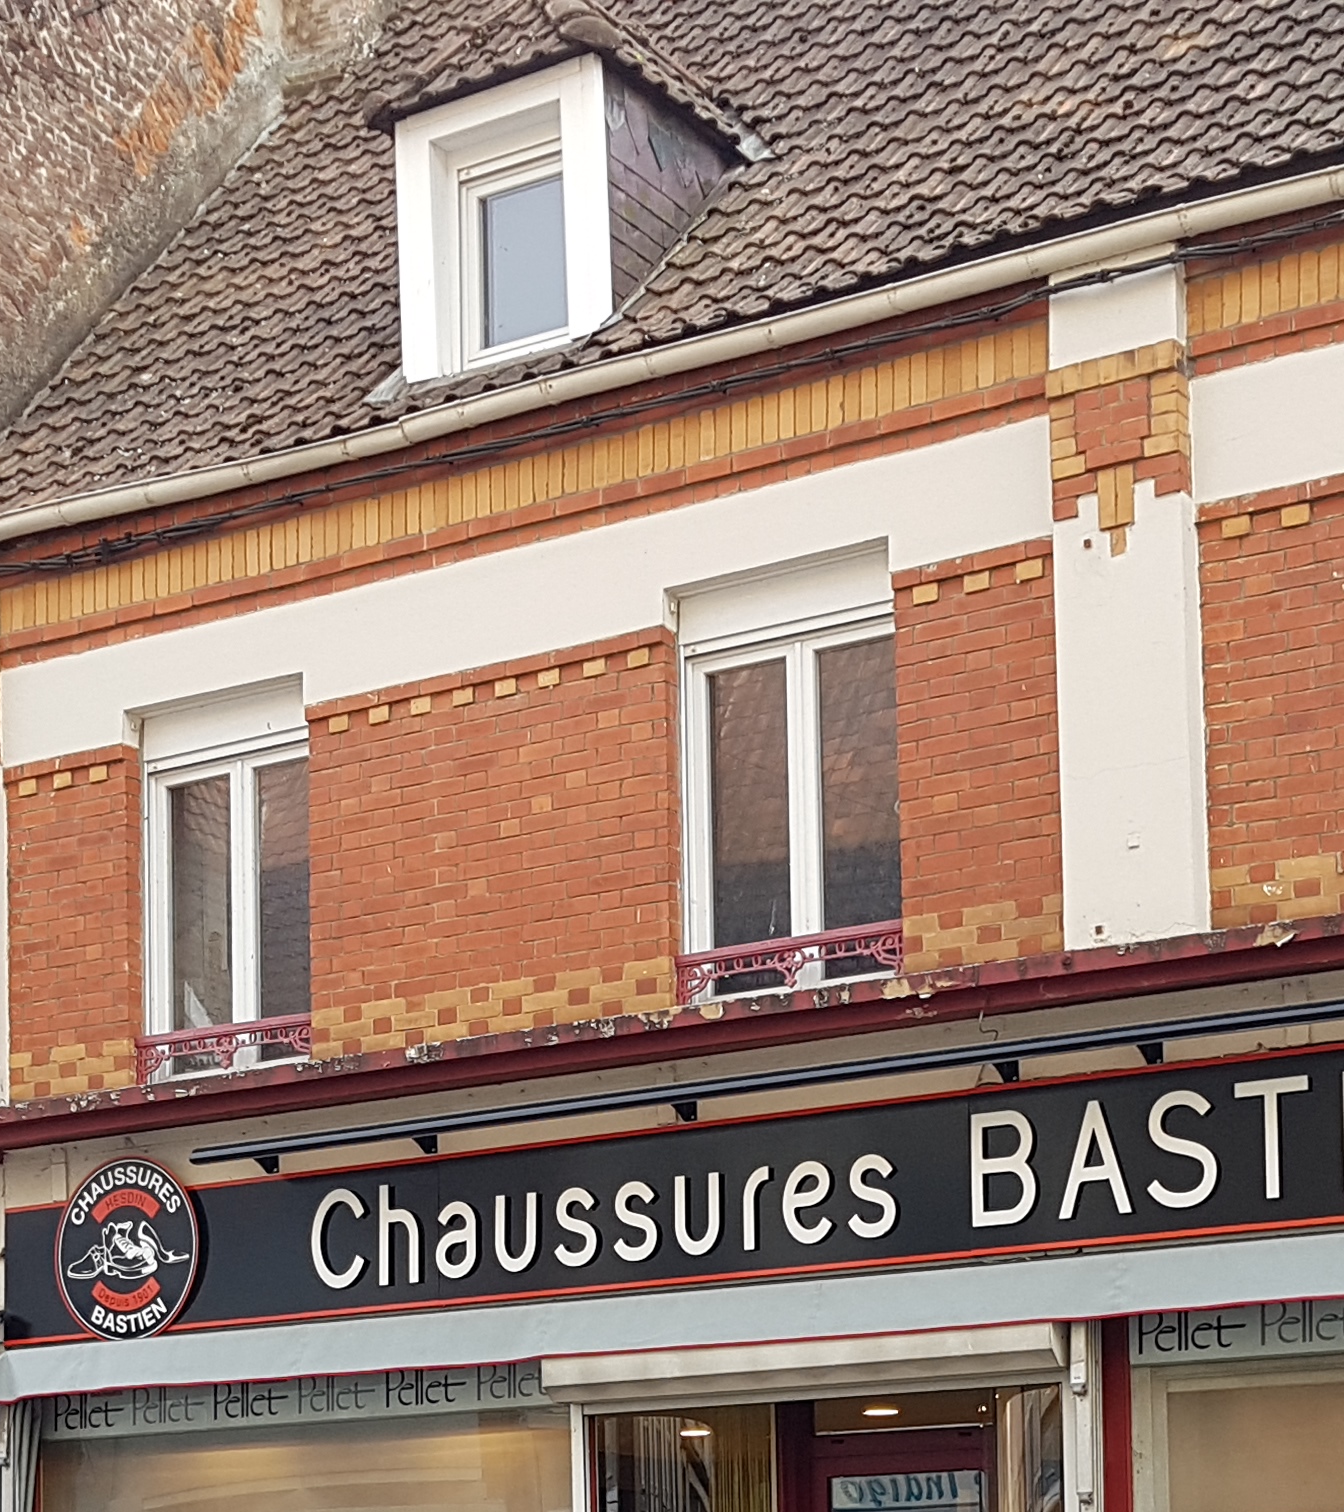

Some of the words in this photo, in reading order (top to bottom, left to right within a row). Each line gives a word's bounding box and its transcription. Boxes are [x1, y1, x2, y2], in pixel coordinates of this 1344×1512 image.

[71, 1166, 181, 1226] CHAUSSURES
[105, 1191, 146, 1211] HESDIN
[311, 1153, 897, 1290] Chaussures
[91, 1297, 168, 1334] BASTIEN
[98, 1288, 130, 1307] Depuis
[132, 1286, 154, 1306] 1901
[1138, 1311, 1247, 1355] Pellet
[54, 1393, 125, 1432] Pellet
[132, 1386, 205, 1426] Pellet
[213, 1381, 289, 1420] Pellet
[297, 1376, 376, 1414] Pellet
[385, 1369, 467, 1408] Pellet
